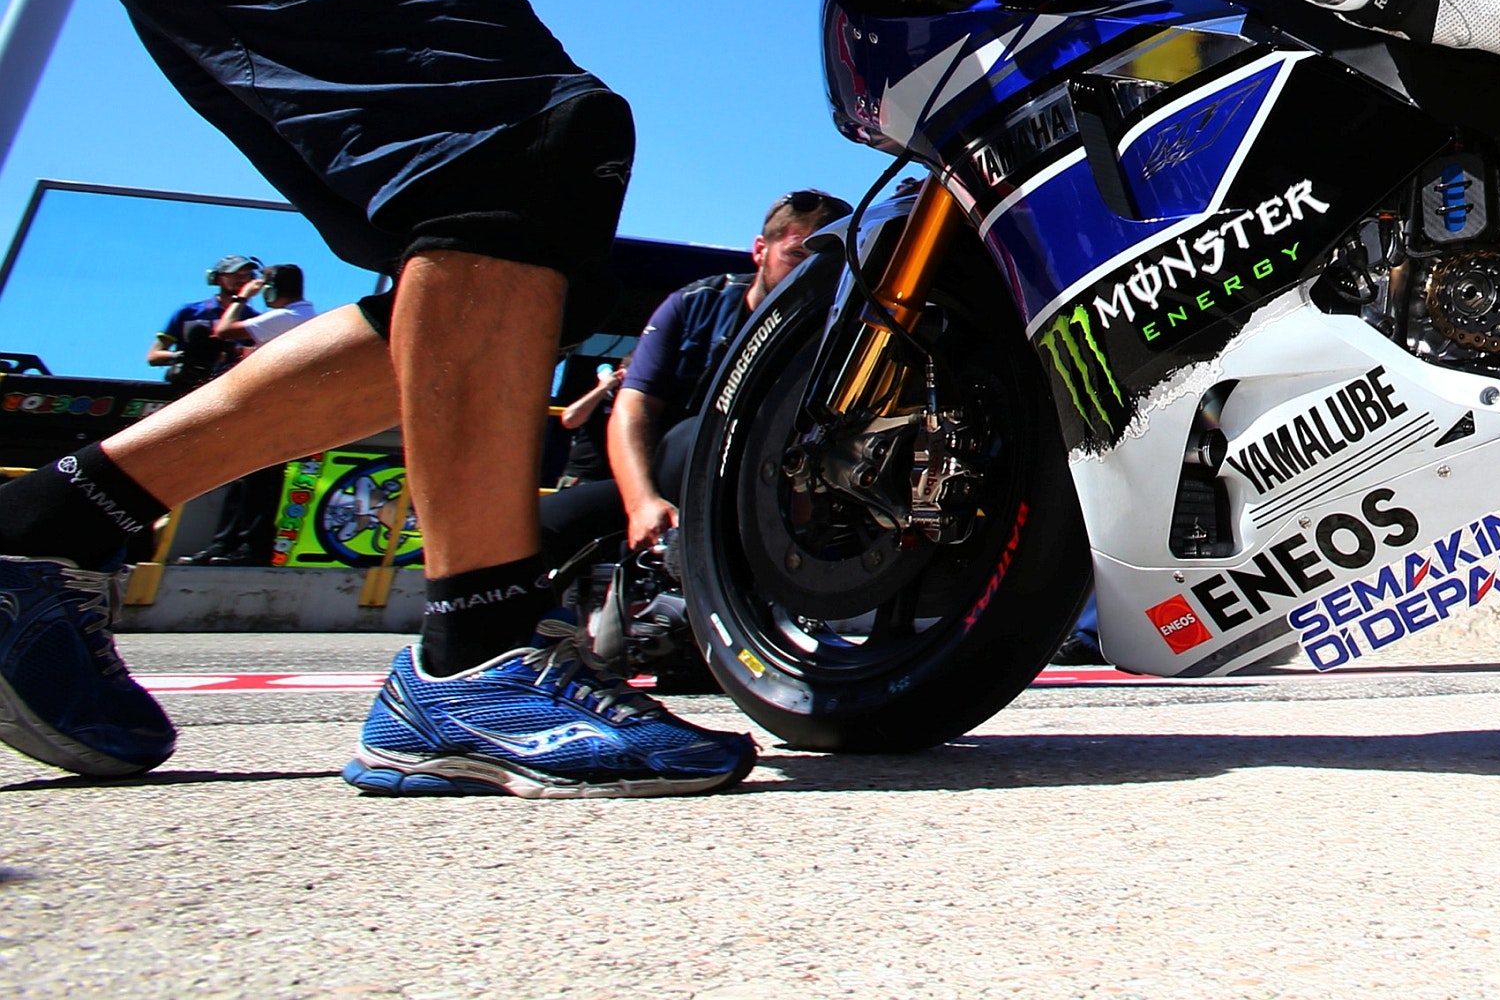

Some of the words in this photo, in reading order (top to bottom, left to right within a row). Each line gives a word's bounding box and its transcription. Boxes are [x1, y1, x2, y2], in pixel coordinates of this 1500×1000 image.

[970, 102, 1070, 184] YAMAHA
[1092, 177, 1331, 330] MONSTER
[1143, 241, 1303, 342] ENERGY
[715, 308, 784, 415] BRIDGESTONE
[1226, 365, 1409, 497] YAMALUBE
[1190, 487, 1421, 634] ENEOS
[1160, 610, 1197, 638] ENEOS
